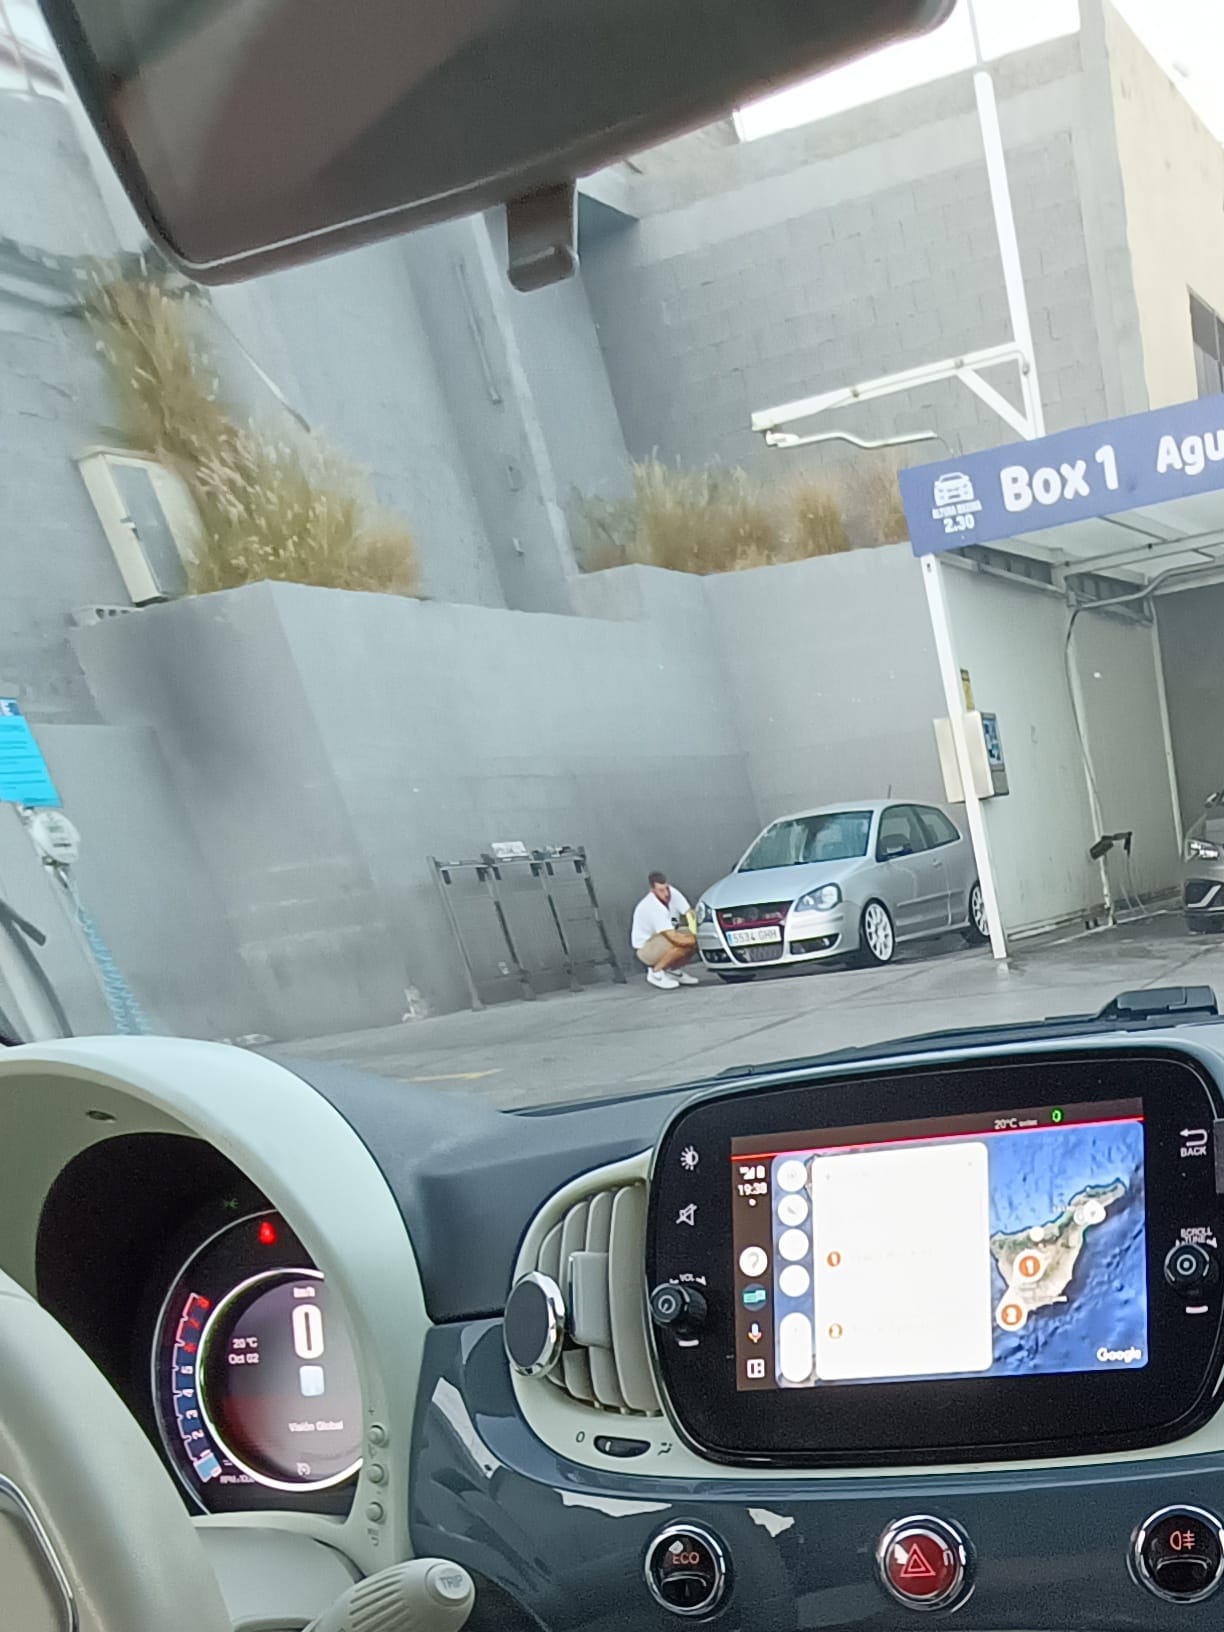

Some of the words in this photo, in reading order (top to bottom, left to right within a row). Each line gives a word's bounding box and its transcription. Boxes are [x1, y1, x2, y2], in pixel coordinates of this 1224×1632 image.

[1000, 459, 1090, 512] Box
[1095, 445, 1119, 490] 1
[943, 513, 975, 533] 2.30
[1180, 1146, 1207, 1157] BACK
[292, 1304, 324, 1360] 0
[1096, 1346, 1142, 1363] Google
[672, 1552, 700, 1565] ECO
[440, 1574, 464, 1589] TRIP
